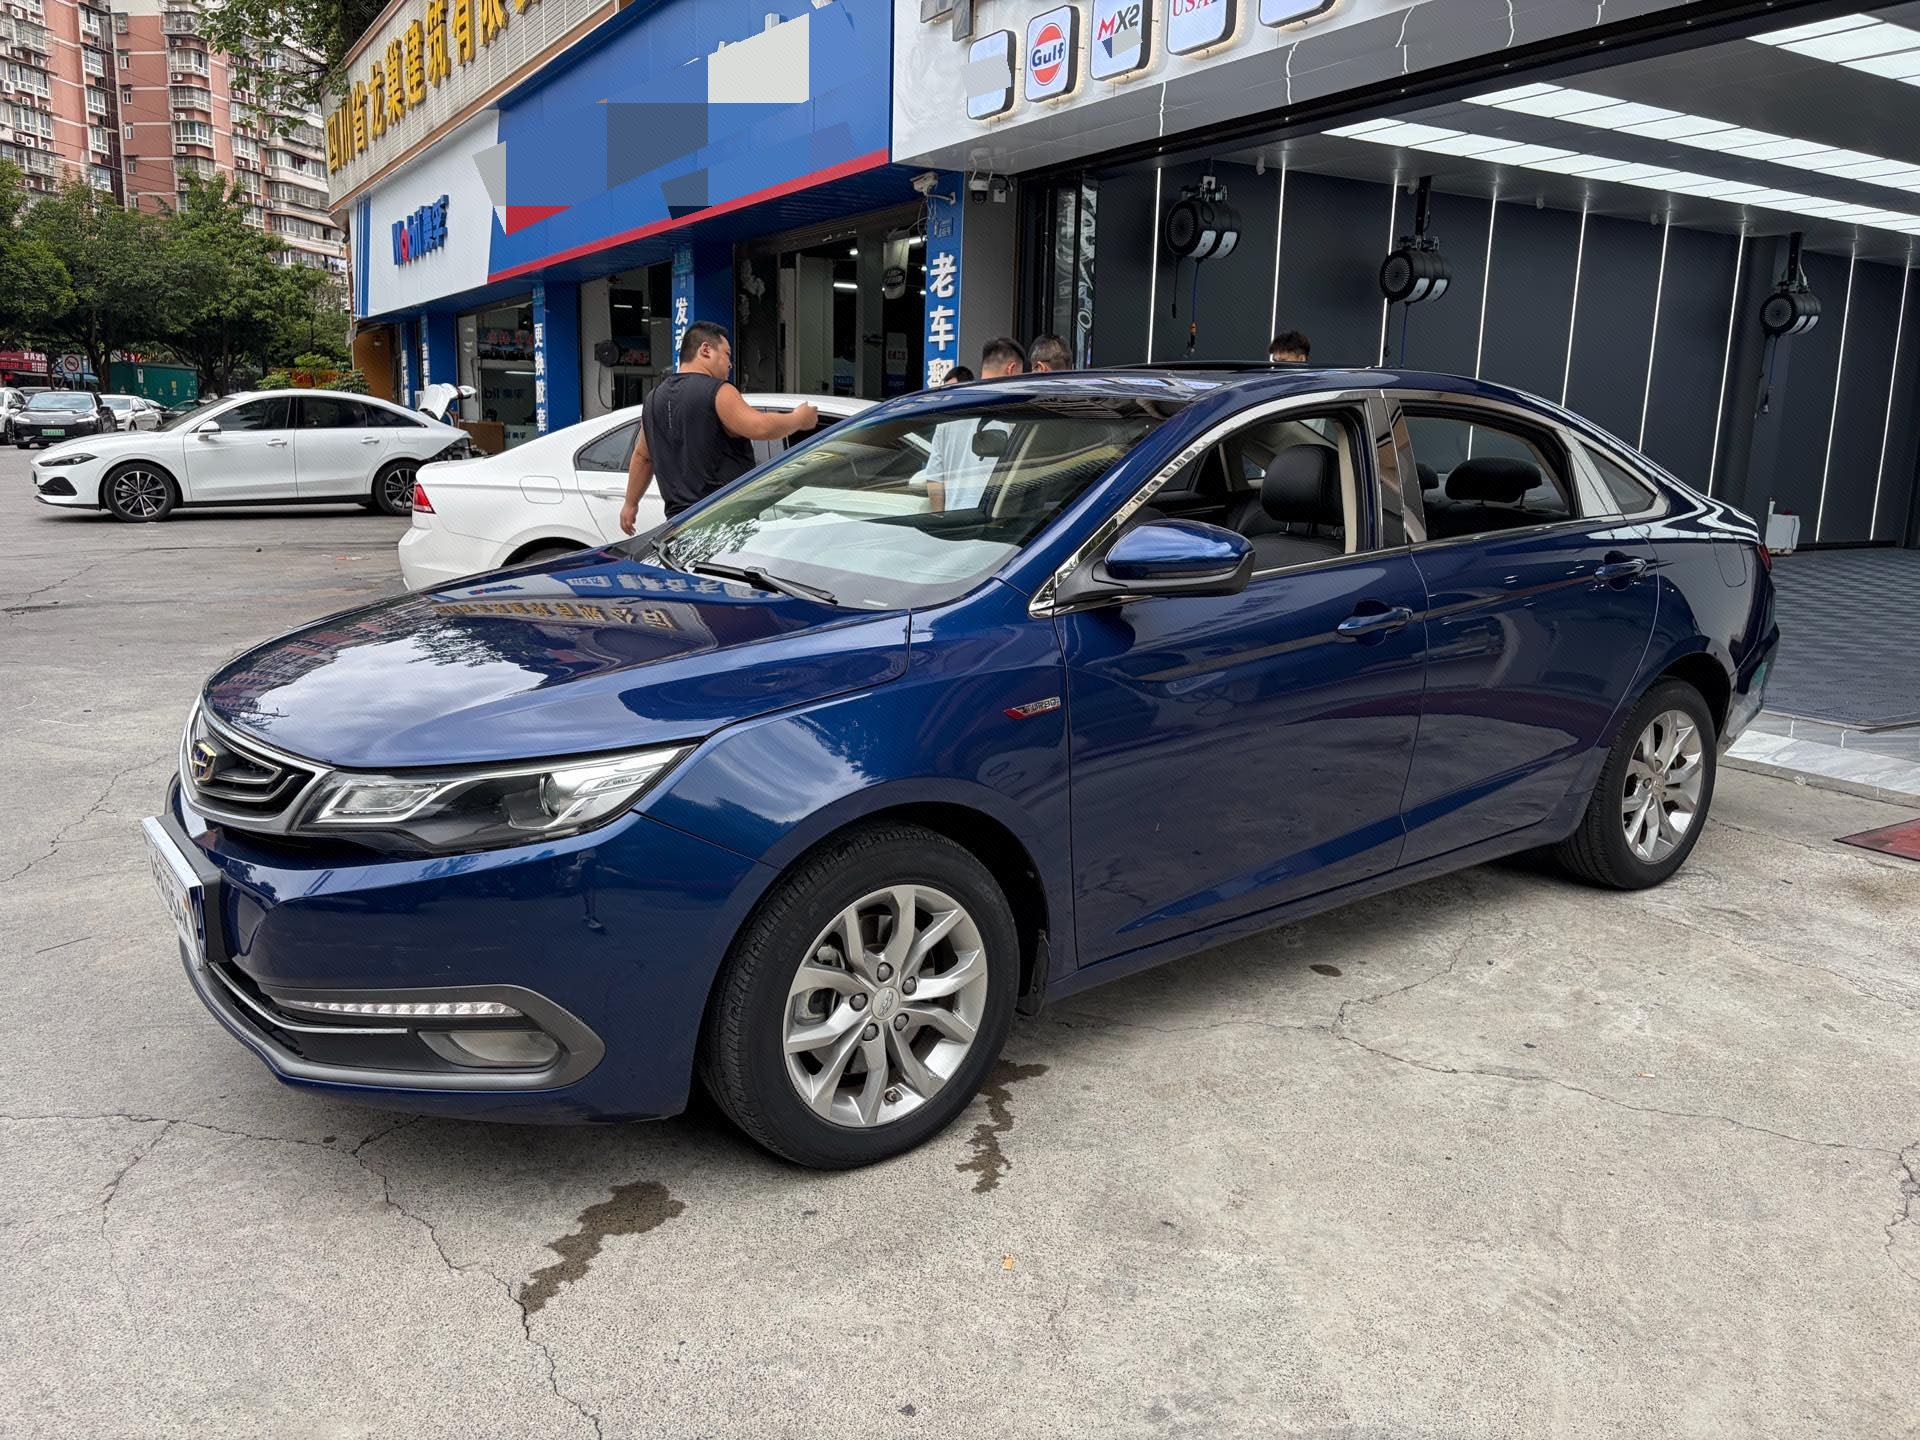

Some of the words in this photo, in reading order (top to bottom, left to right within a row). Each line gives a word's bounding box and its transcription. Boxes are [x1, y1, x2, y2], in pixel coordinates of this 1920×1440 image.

[1097, 4, 1140, 40] MX2
[1032, 42, 1065, 68] Gulf
[327, 0, 539, 174] 四川省龙巢建筑有
